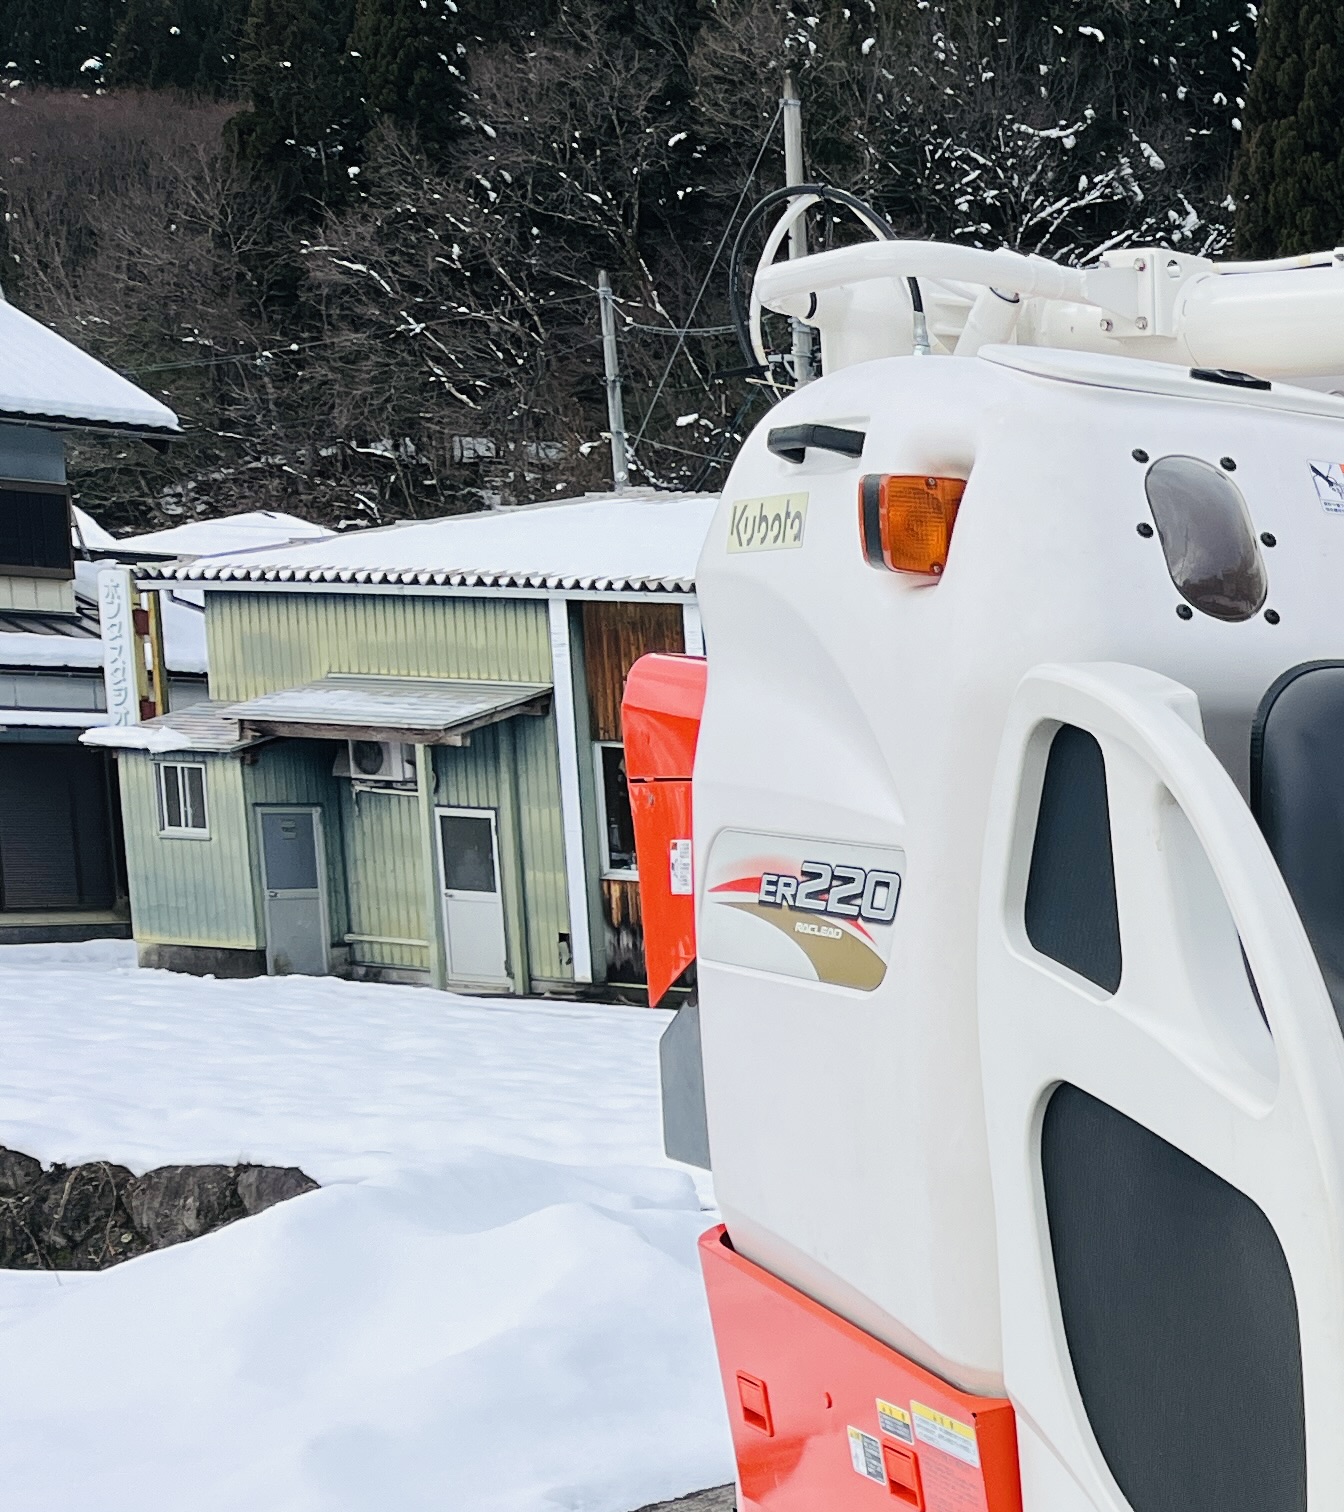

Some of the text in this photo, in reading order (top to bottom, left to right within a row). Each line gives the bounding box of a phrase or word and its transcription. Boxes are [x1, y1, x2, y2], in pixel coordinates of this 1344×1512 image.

[730, 499, 803, 547] Kubota
[759, 860, 901, 925] ER220
[795, 922, 843, 940] RACLEAD
